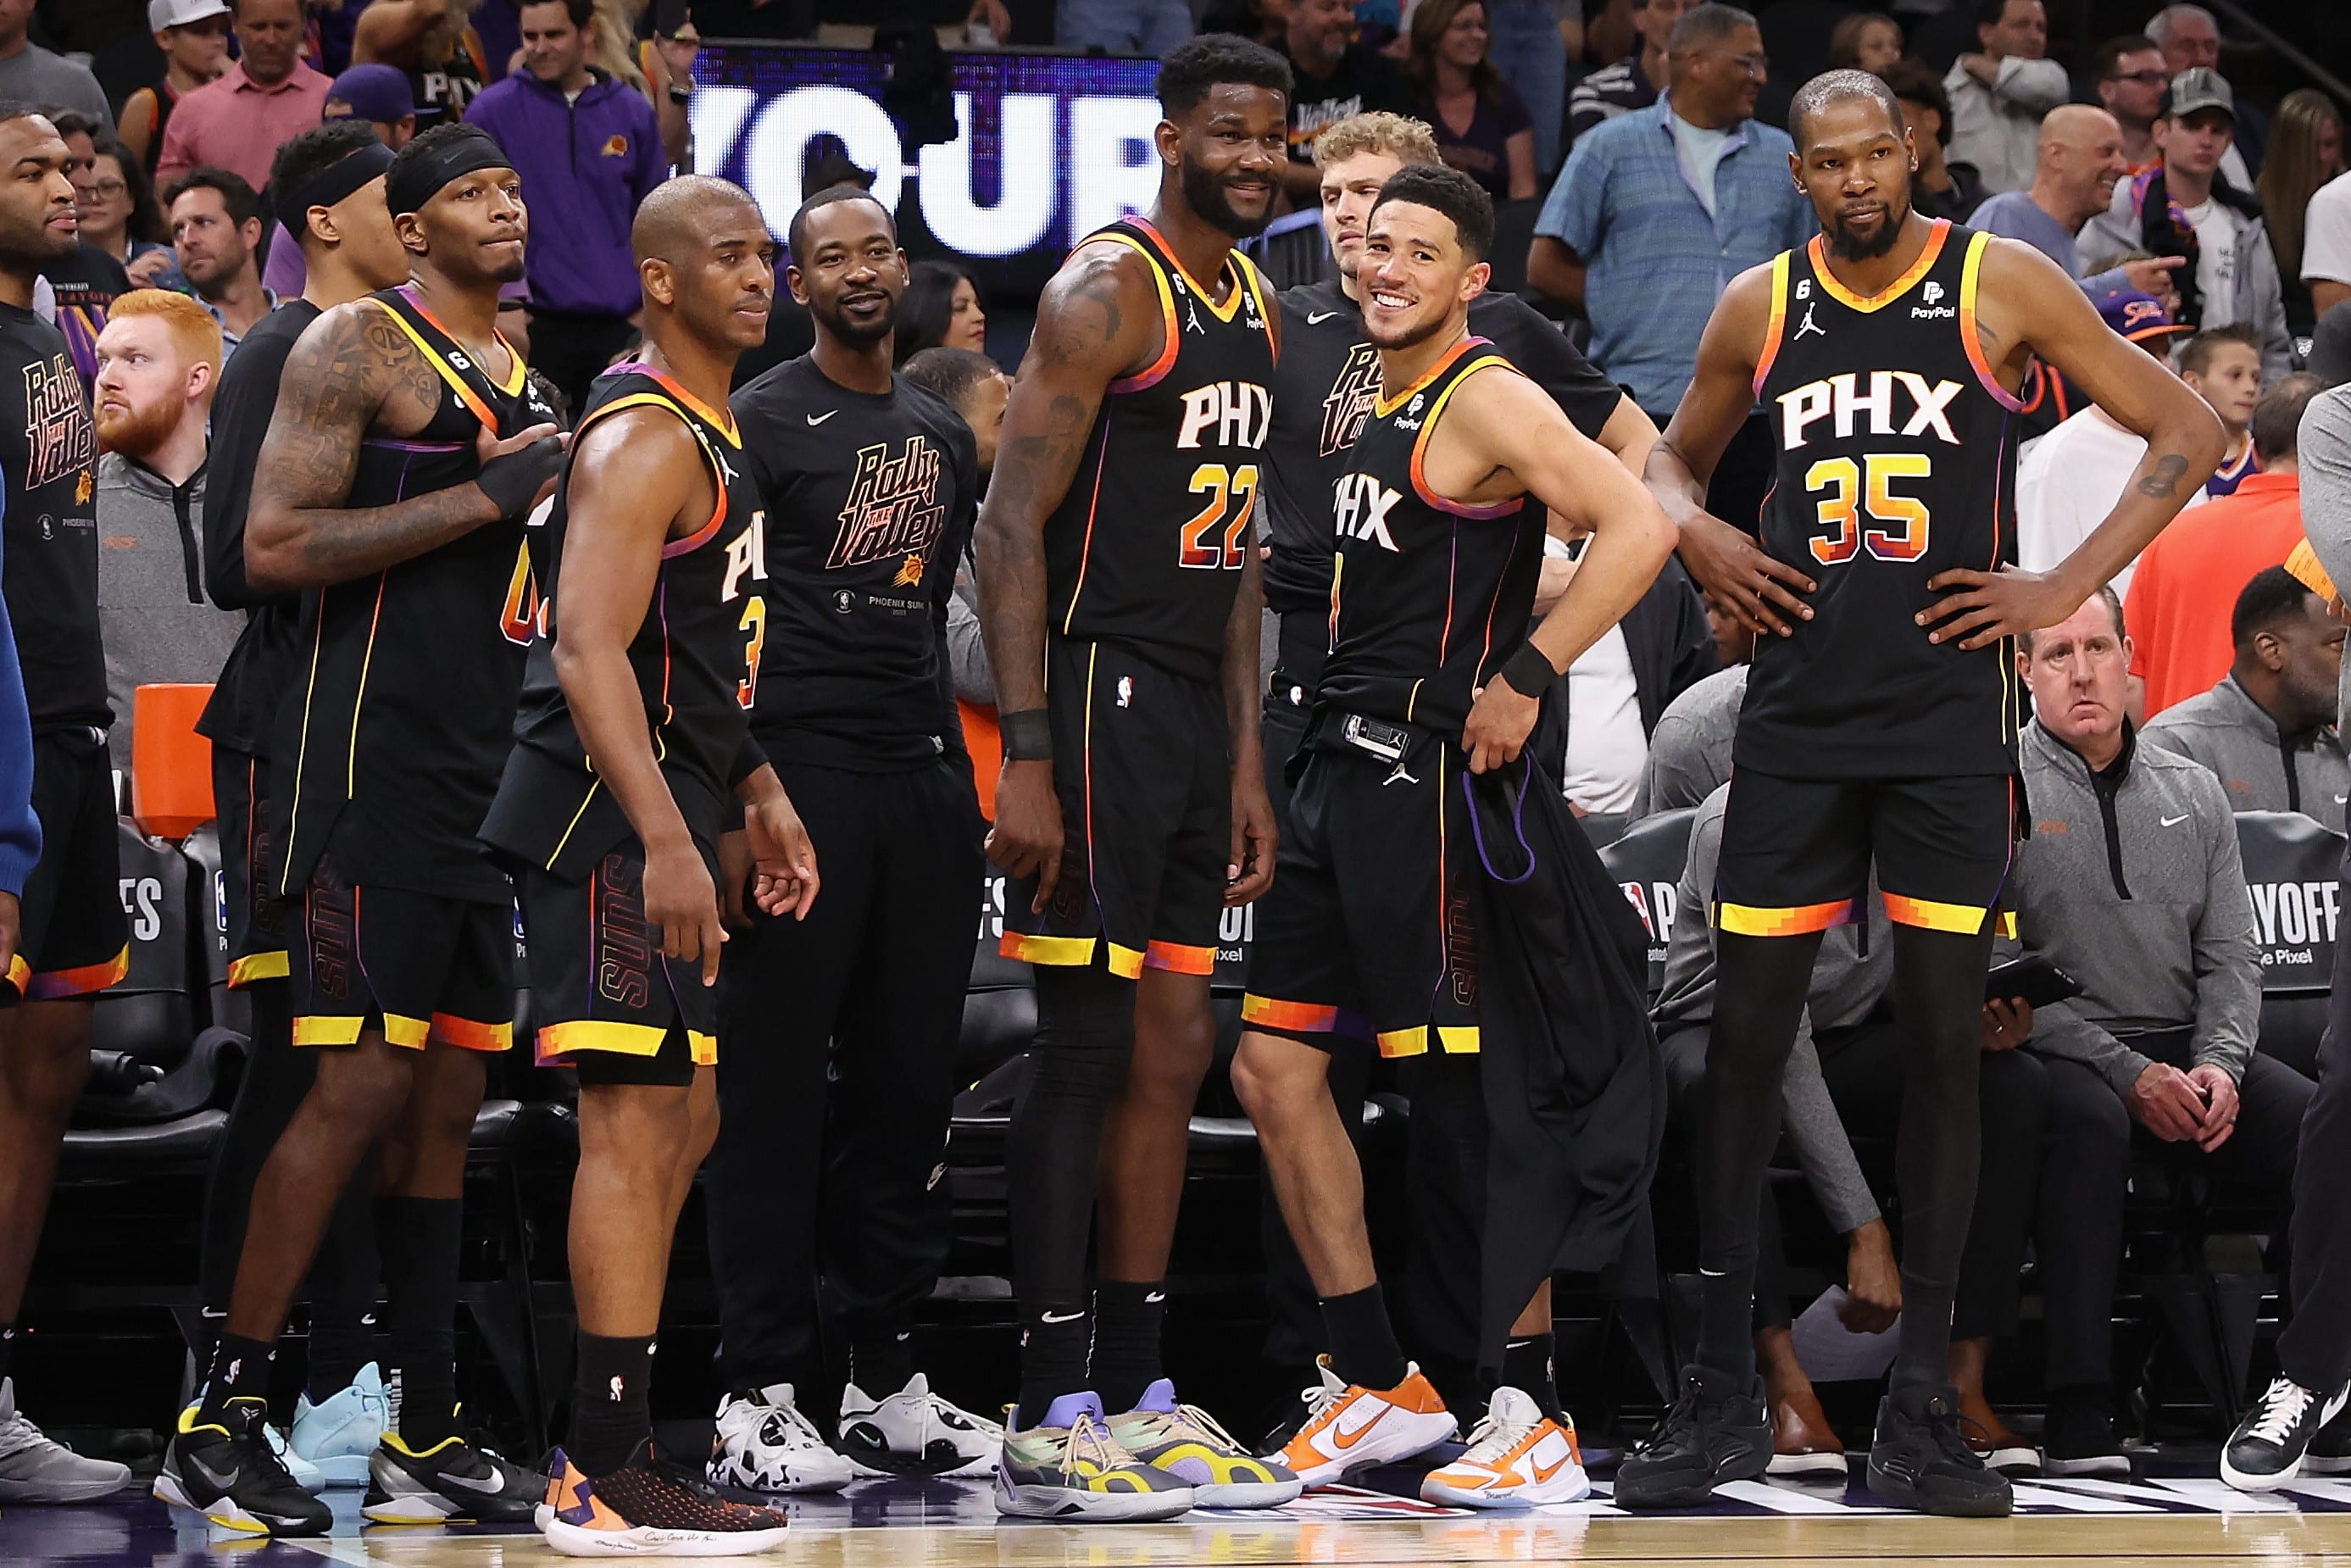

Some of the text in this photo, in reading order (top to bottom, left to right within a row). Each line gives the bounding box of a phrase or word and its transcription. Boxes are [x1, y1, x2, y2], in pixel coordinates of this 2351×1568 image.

[1172, 273, 1186, 295] 6
[1796, 278, 1811, 300] 6
[1910, 306, 1956, 320] PayPal
[447, 351, 471, 370] 6
[1775, 370, 1965, 451] PHX
[1394, 416, 1422, 431] PayPal
[844, 435, 940, 513] Rally
[867, 510, 891, 527] THE
[1178, 463, 1259, 570] 22
[1331, 472, 1404, 553] HX
[1804, 453, 1931, 566] 35
[825, 495, 945, 570] Valley
[869, 596, 905, 609] PHOENIX
[736, 595, 766, 710] 3
[2246, 881, 2341, 945] YOFF
[1215, 947, 1243, 963] ixel
[2275, 948, 2313, 965] Pixel
